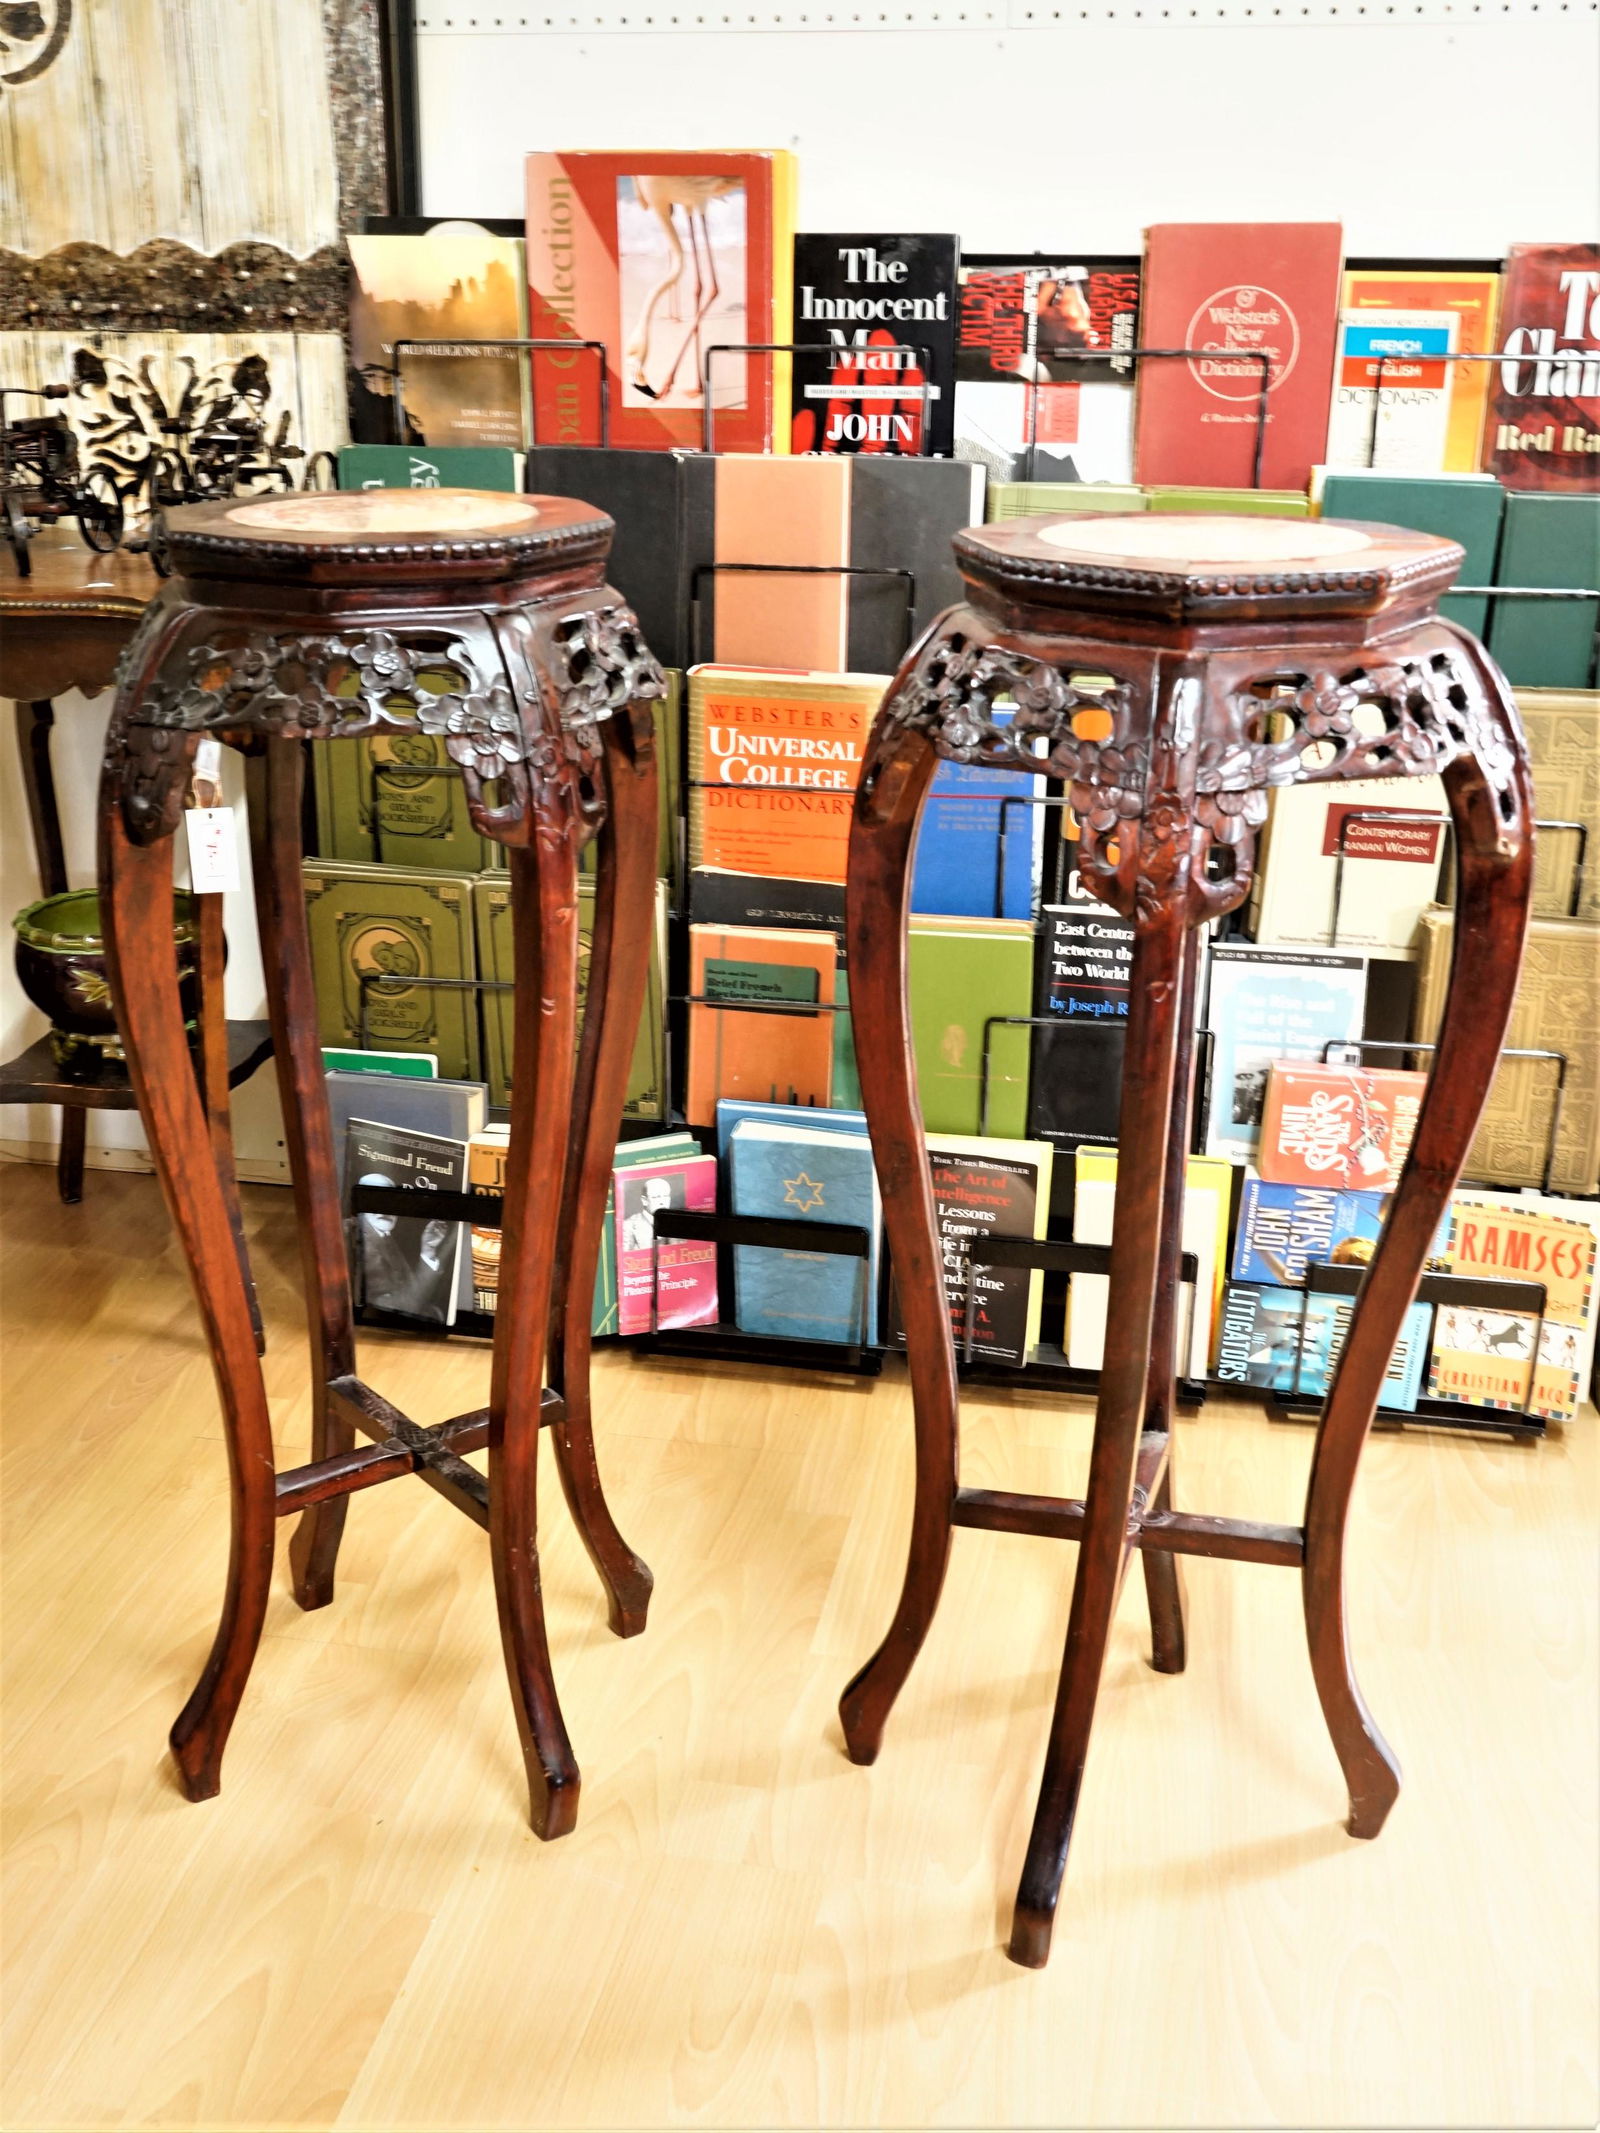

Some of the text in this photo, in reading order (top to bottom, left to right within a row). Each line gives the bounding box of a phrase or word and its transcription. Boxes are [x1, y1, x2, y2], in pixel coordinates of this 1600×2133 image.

[542, 177, 580, 369] Collection
[838, 248, 909, 283] The
[800, 286, 950, 321] Innocent
[1112, 273, 1139, 316] LISA
[960, 273, 995, 347] VICTIM
[1088, 273, 1114, 349] GARDNE
[1208, 307, 1280, 325] Webster's
[1559, 271, 1600, 340] T
[989, 272, 1026, 372] THE THIRD
[1226, 325, 1264, 341] New
[381, 344, 425, 357] WRLD
[826, 328, 919, 370] Man
[1369, 340, 1422, 352] FRENCH
[1200, 360, 1285, 381] Dictionay
[1366, 364, 1422, 377] EGLISH
[1338, 389, 1438, 404] DICTONAR
[826, 413, 915, 441] JOHN
[1496, 425, 1555, 451] Red
[709, 704, 861, 729] WEBSTER'S
[707, 726, 862, 762] UNIVERSAL
[719, 757, 850, 789] COLLEGE
[379, 814, 437, 824] OOKSHELF
[1346, 824, 1432, 841] CONTEMPORARY
[1385, 842, 1430, 856] WOMEN
[1055, 920, 1136, 941] East Centra
[1054, 940, 1133, 961] between th
[1052, 961, 1130, 981] Two World
[374, 1007, 407, 1020] GIRLS
[1049, 996, 1065, 1013] by
[1065, 997, 1115, 1017] Joseph
[368, 1018, 421, 1031] OOKSHELF
[1278, 1104, 1312, 1156] TIME
[1304, 1090, 1354, 1171] SANDS
[358, 1144, 453, 1175] Sigmund Freud
[934, 1168, 1007, 1189] The Art of
[932, 1187, 1012, 1206] ntelligence
[938, 1203, 996, 1221] Lessons
[942, 1220, 989, 1236] from a
[1245, 1219, 1255, 1236] TIMES
[1252, 1206, 1292, 1255] JOHN
[938, 1236, 956, 1252] ife
[1459, 1222, 1584, 1280] RAMSES
[623, 1245, 715, 1271] Sigmnd Freud
[1242, 1255, 1251, 1267] NEW
[623, 1271, 670, 1287] Beyon he
[623, 1277, 699, 1297] Pleasu Principle
[945, 1290, 987, 1305] ervce
[1218, 1288, 1261, 1382] LITIGATORS
[1252, 1332, 1268, 1346] THE
[1443, 1370, 1566, 1405] CHRISTIAN ACQ
